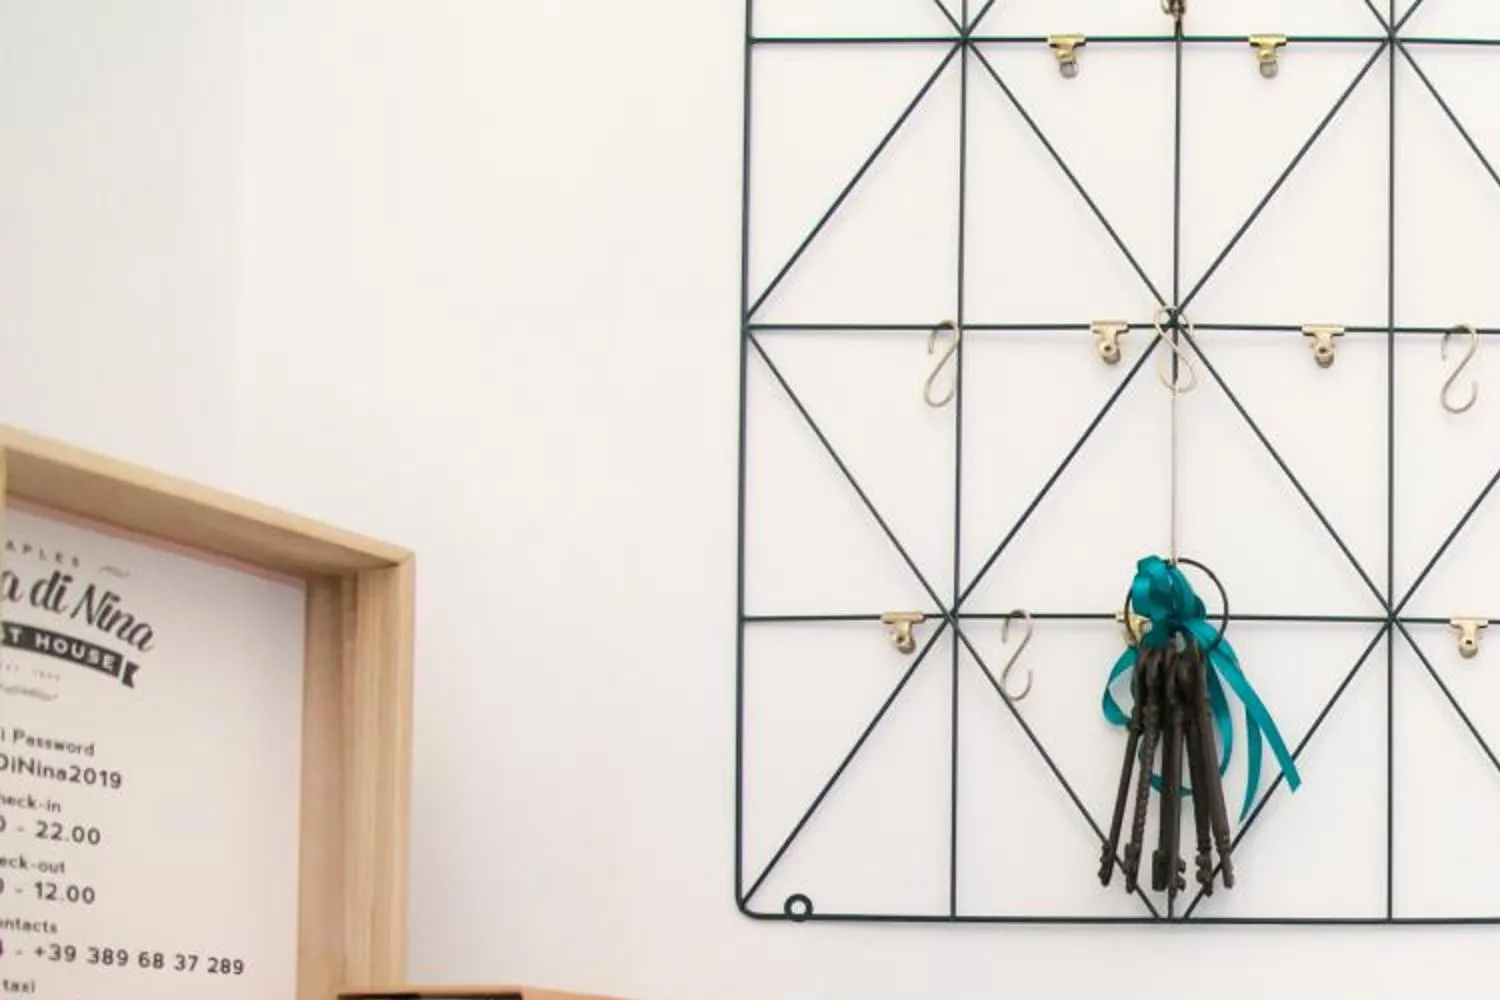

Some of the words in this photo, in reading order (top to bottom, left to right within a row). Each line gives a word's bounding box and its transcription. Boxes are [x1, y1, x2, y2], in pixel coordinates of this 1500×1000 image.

[5, 539, 81, 568] APLES
[30, 569, 73, 614] di
[70, 582, 155, 652] Nina
[34, 632, 116, 672] HOUSE
[13, 728, 95, 757] Password
[0, 752, 122, 789] DiNina2019
[35, 819, 101, 845] 22.00
[0, 854, 65, 874] eck-out
[34, 881, 96, 905] 12.00
[0, 917, 58, 934] ntacts
[34, 943, 77, 963] +39
[86, 946, 129, 967] 389
[138, 951, 165, 970] 68
[173, 953, 199, 972] 37
[207, 956, 244, 975] 289
[3, 979, 36, 993] taxi
